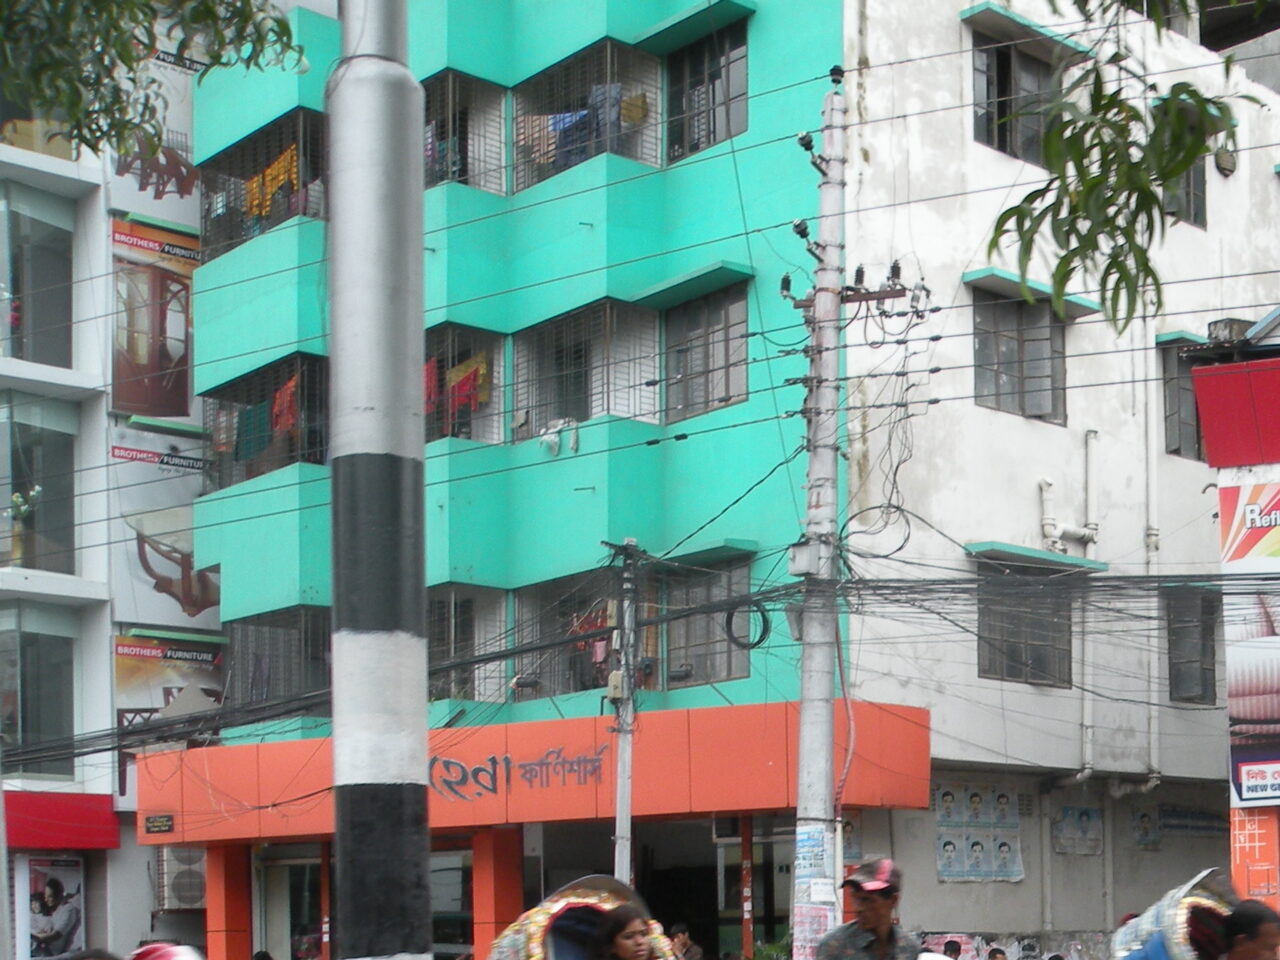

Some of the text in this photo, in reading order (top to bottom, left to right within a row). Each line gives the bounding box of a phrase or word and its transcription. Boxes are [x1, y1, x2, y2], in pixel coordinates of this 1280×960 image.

[114, 233, 160, 250] BROTHERS
[117, 646, 213, 661] BROTHERS FURNITURE
[1246, 783, 1268, 793] NEW
